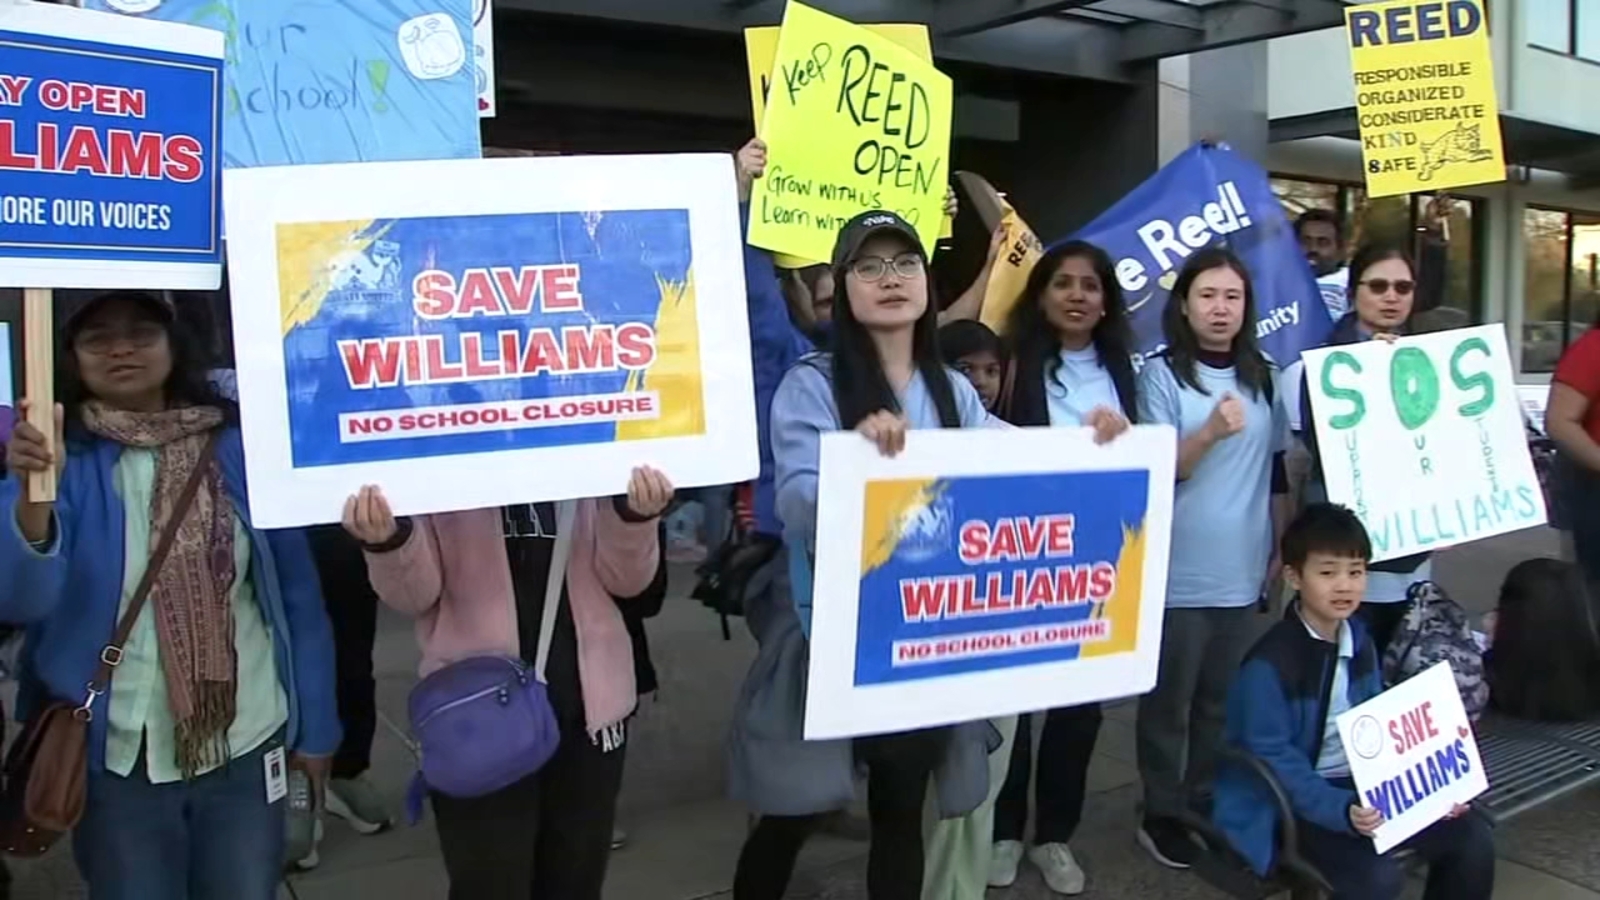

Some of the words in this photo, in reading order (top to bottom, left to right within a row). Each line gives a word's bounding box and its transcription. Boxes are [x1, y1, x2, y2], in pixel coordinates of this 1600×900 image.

[1349, 1, 1481, 47] REED
[1354, 62, 1471, 85] RESPONSIBLE
[39, 79, 146, 118] OPEN
[836, 44, 931, 149] REED
[1358, 86, 1465, 107] ORGANIZED
[1360, 104, 1484, 128] CONSIDERATE
[1364, 131, 1418, 150] KIND
[854, 140, 940, 195] OPEN
[0, 195, 47, 225] ORE
[52, 199, 95, 227] OUR
[100, 201, 171, 231] VOICES
[762, 194, 809, 226] Learn
[816, 213, 846, 230] WIT
[819, 182, 857, 203] WITH
[859, 189, 882, 209] US
[413, 263, 581, 320] SAVE
[336, 321, 657, 391] WILLIAMS
[349, 414, 393, 436] NO
[399, 405, 519, 432] SCHOOL
[522, 397, 654, 422] CLOSURE
[959, 513, 1074, 565] SAVE
[899, 560, 1116, 624] WILLIAMS
[898, 644, 932, 660] NO
[935, 636, 1017, 657] SCHOOL
[1020, 622, 1106, 647] CLOSURE
[1388, 700, 1439, 755] SAVE
[1364, 738, 1470, 820] WILLIAMS
